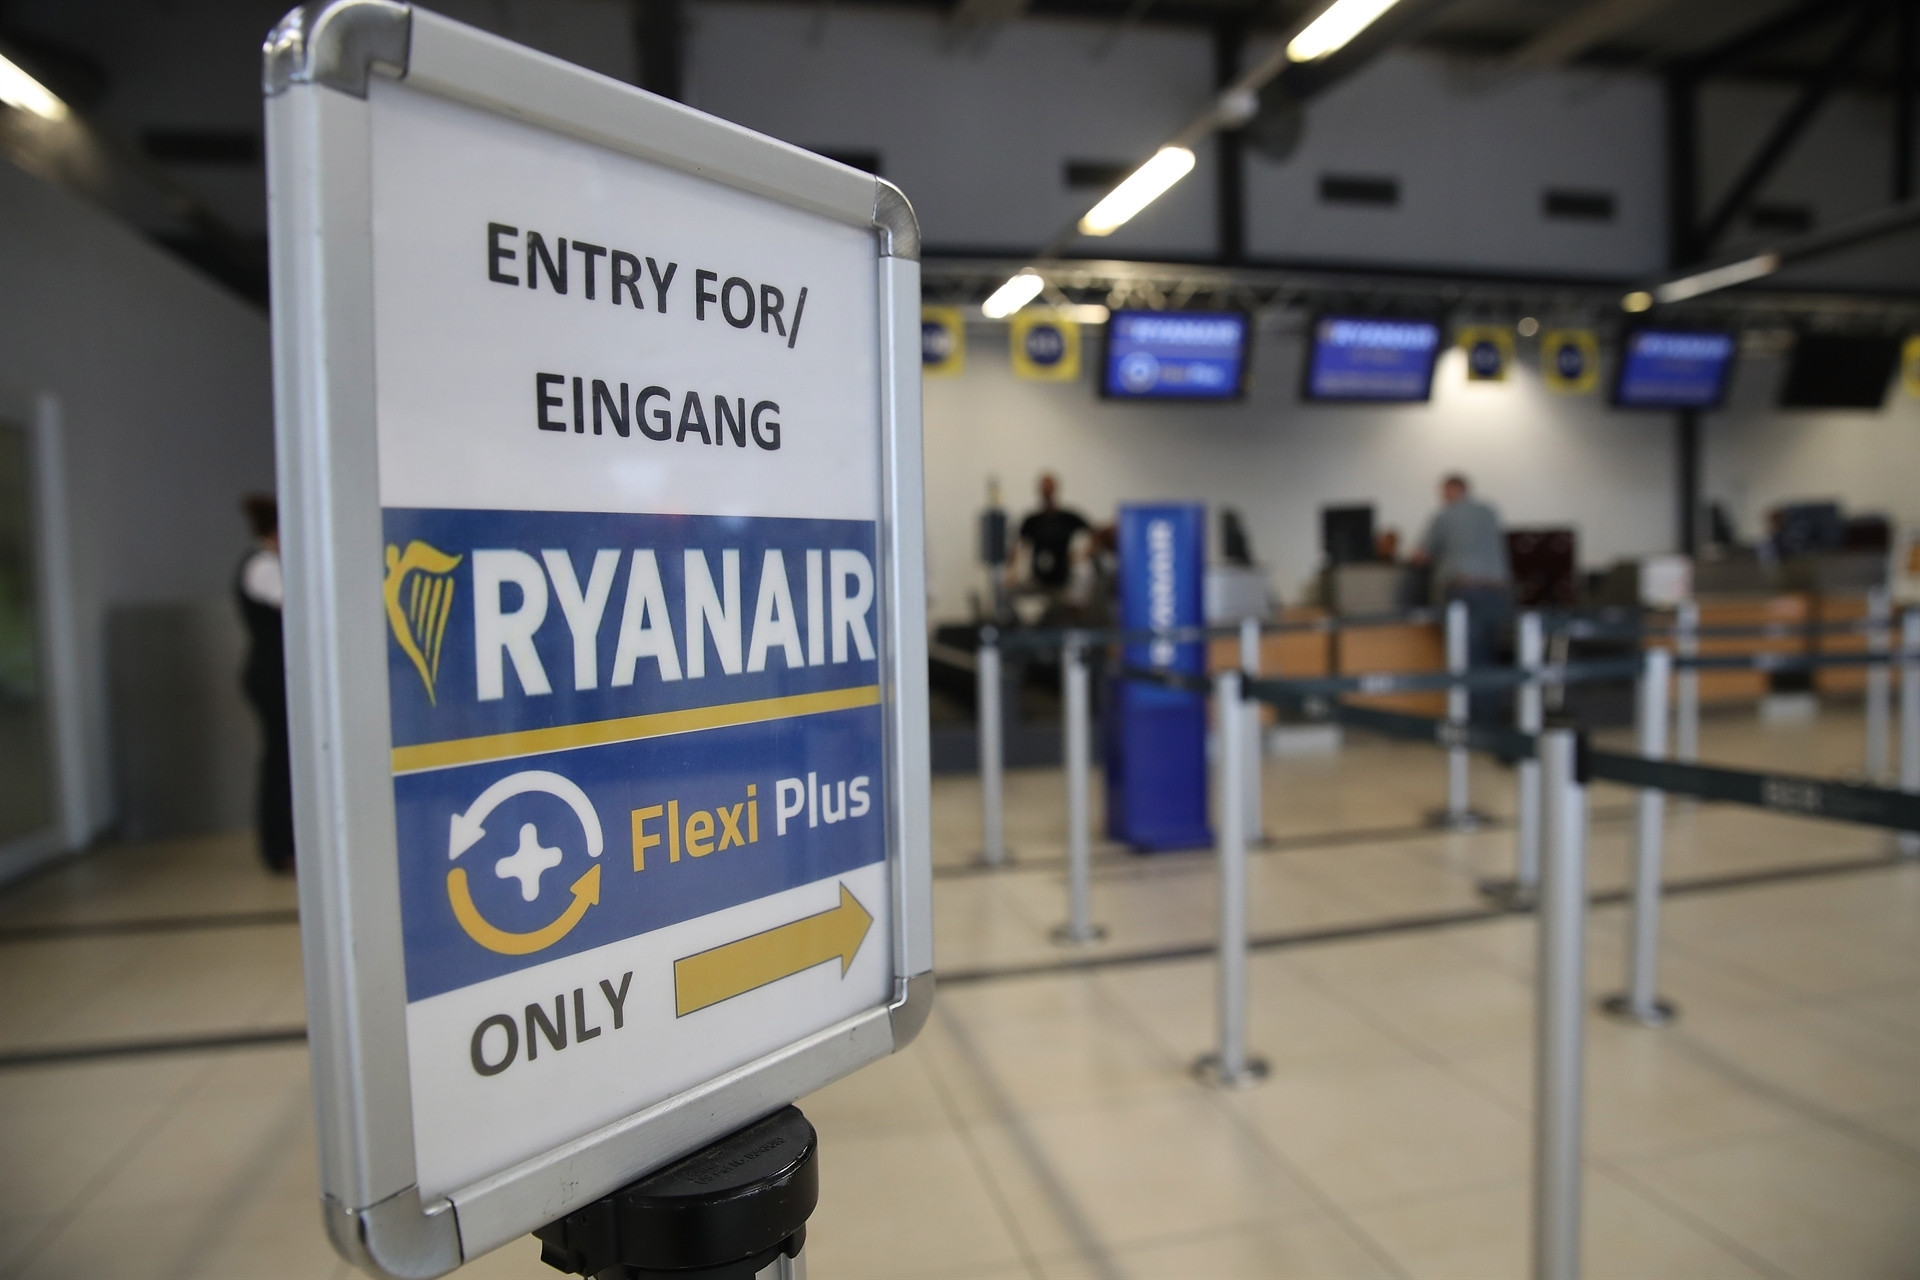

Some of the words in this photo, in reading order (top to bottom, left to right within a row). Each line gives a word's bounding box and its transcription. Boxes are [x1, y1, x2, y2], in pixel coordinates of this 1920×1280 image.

[487, 222, 678, 314] ENTRY
[695, 268, 808, 349] FOR/
[536, 372, 782, 452] EINGANG
[472, 549, 877, 702] RYANAIR
[631, 783, 759, 873] Flexi
[775, 772, 871, 837] Plus
[470, 971, 633, 1077] ONLY
